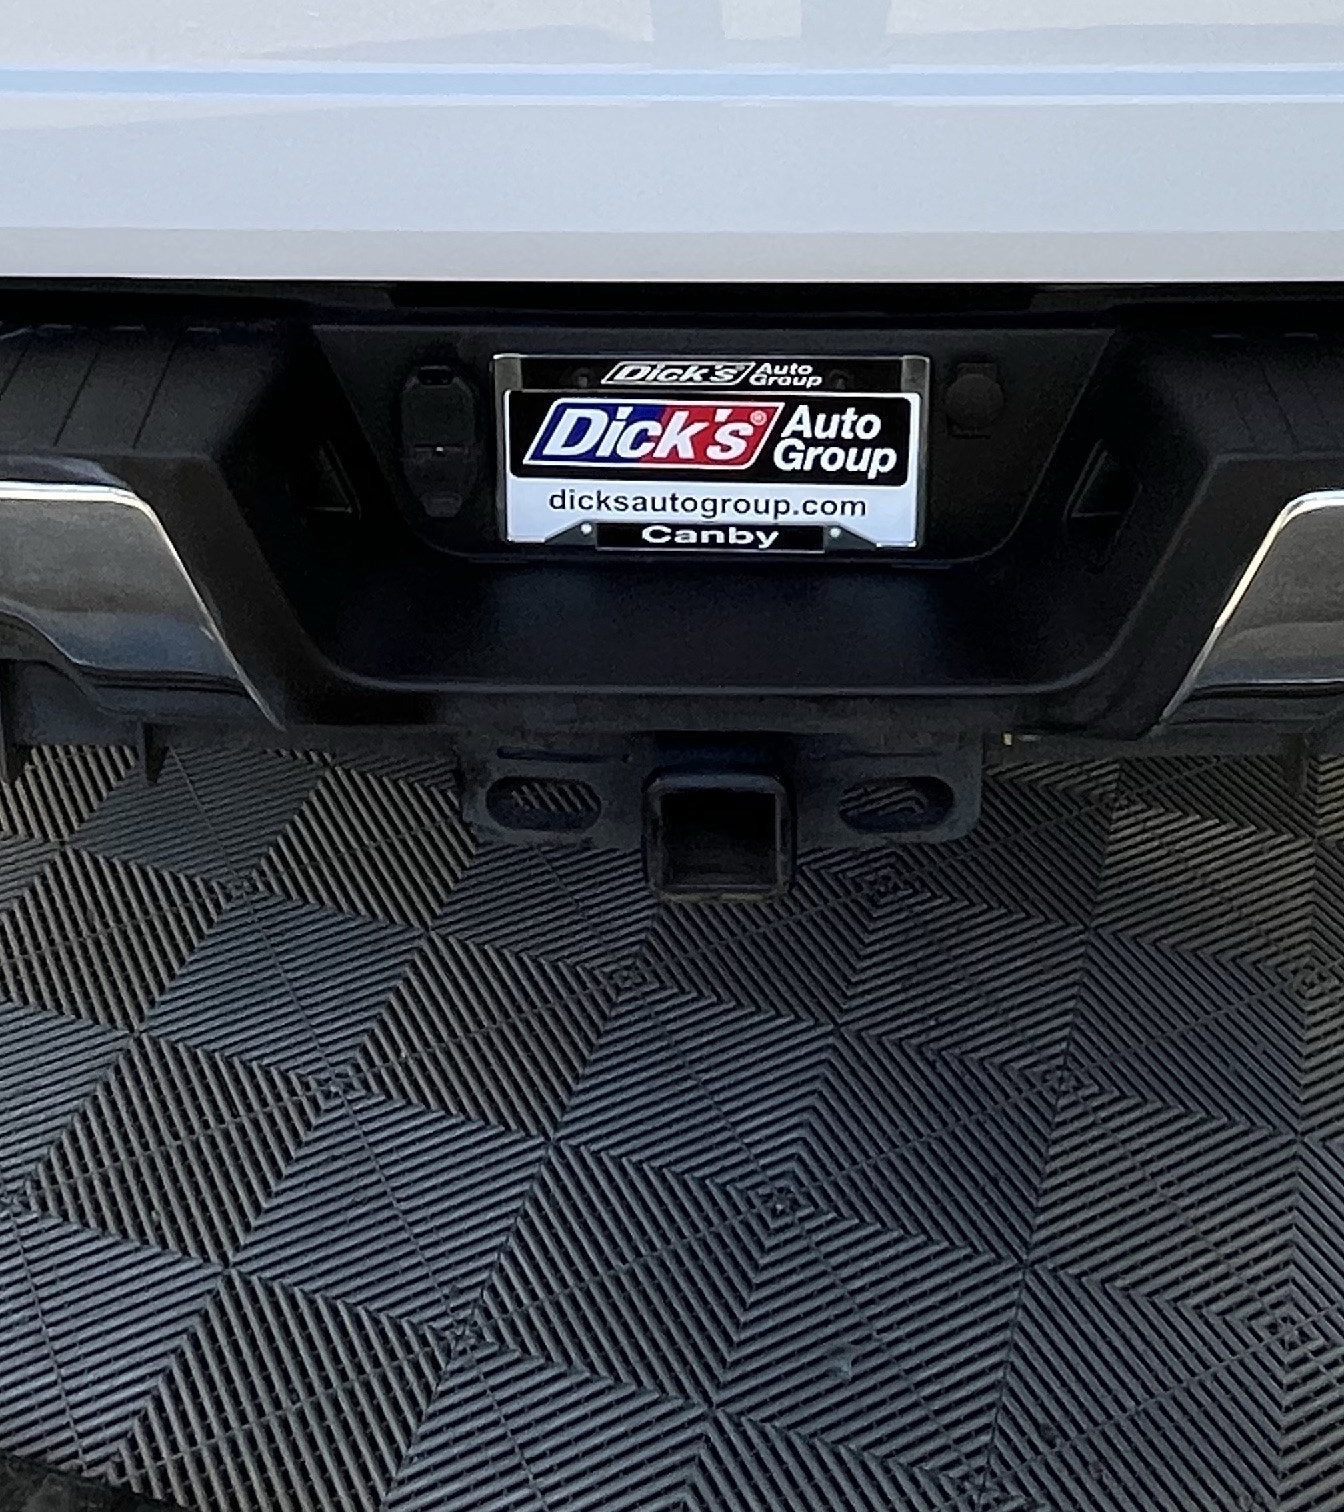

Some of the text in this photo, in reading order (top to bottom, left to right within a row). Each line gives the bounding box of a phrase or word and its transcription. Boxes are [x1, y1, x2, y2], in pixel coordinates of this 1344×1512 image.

[748, 375, 823, 389] Group
[754, 362, 814, 376] Auto
[780, 404, 882, 440] Auto
[773, 437, 898, 480] Group
[548, 488, 867, 520] dicksautogroup.com
[641, 524, 780, 549] Canby
